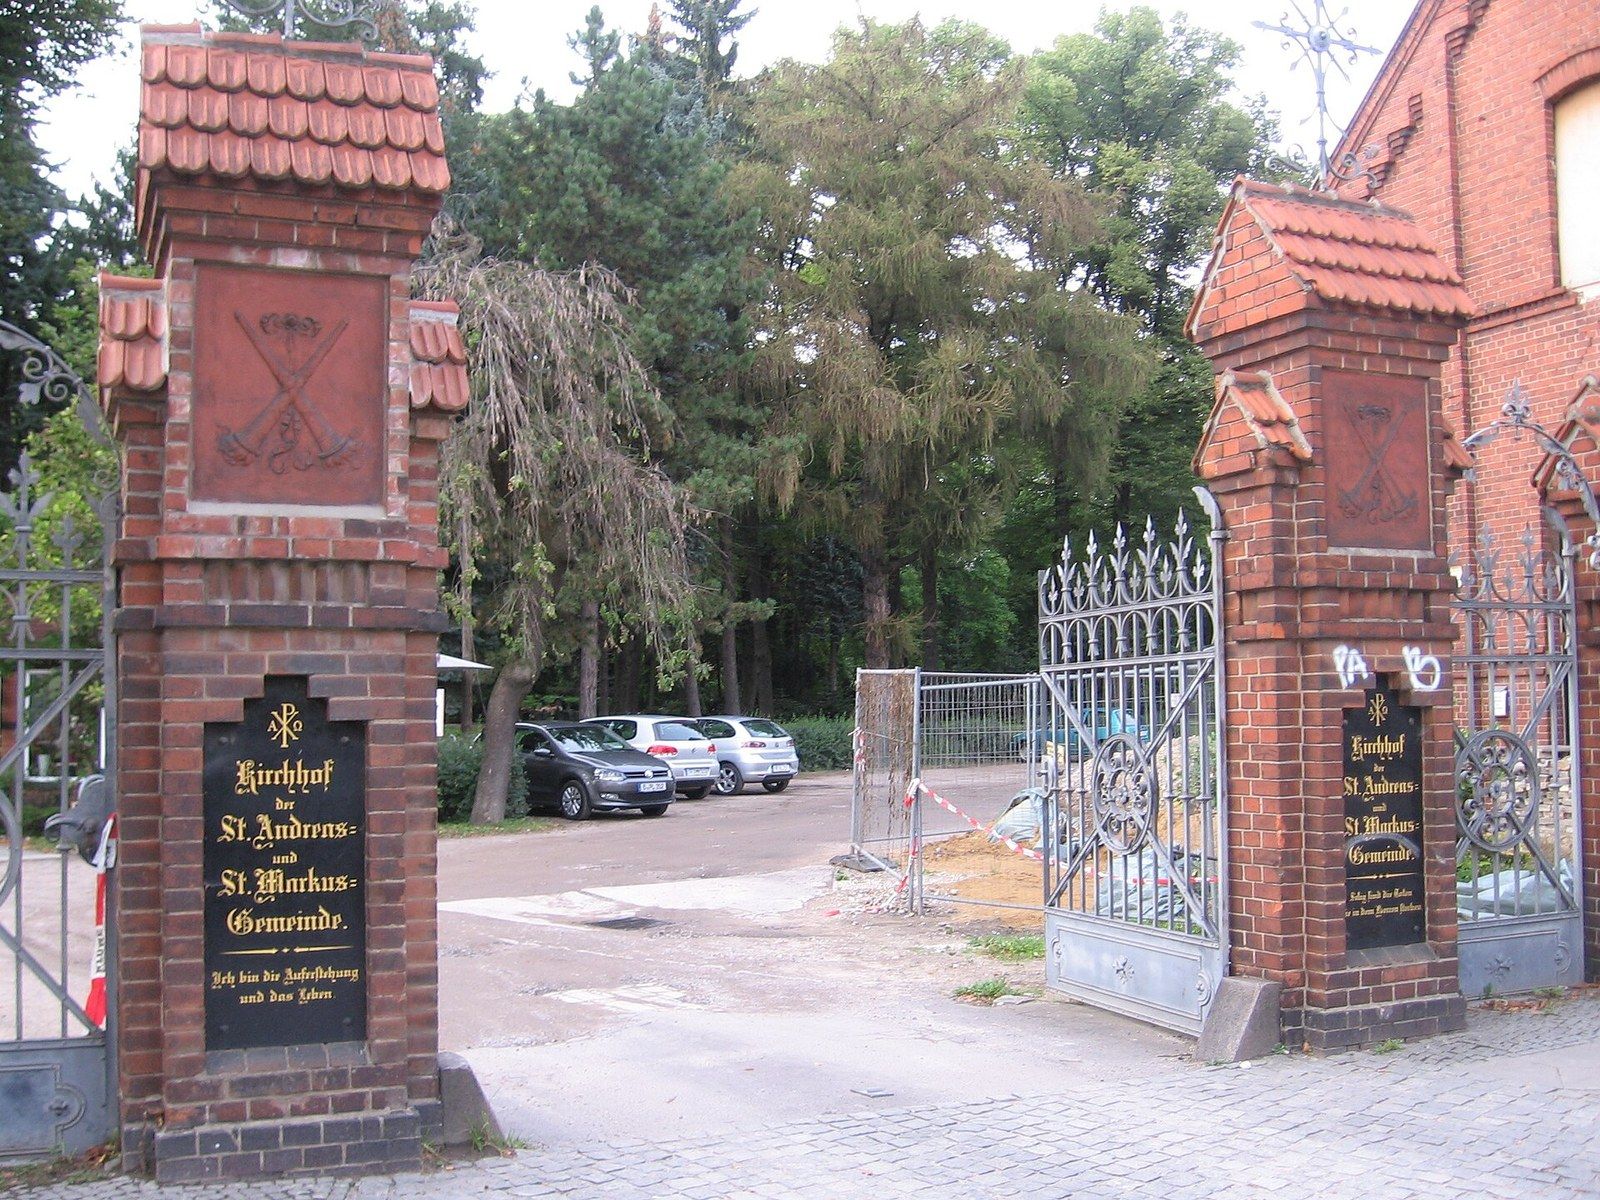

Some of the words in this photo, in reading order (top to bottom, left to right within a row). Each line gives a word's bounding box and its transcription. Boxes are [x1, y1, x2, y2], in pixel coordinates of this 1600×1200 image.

[1351, 733, 1405, 761] Kirchhof
[234, 758, 335, 795] Kirchhof
[275, 797, 295, 810] der
[217, 814, 251, 843] St.
[272, 851, 298, 864] und
[217, 868, 252, 897] St.
[226, 905, 348, 935] Gemeinde.
[239, 970, 259, 984] bin
[263, 969, 281, 982] die
[239, 991, 264, 1004] und
[269, 989, 294, 1003] das
